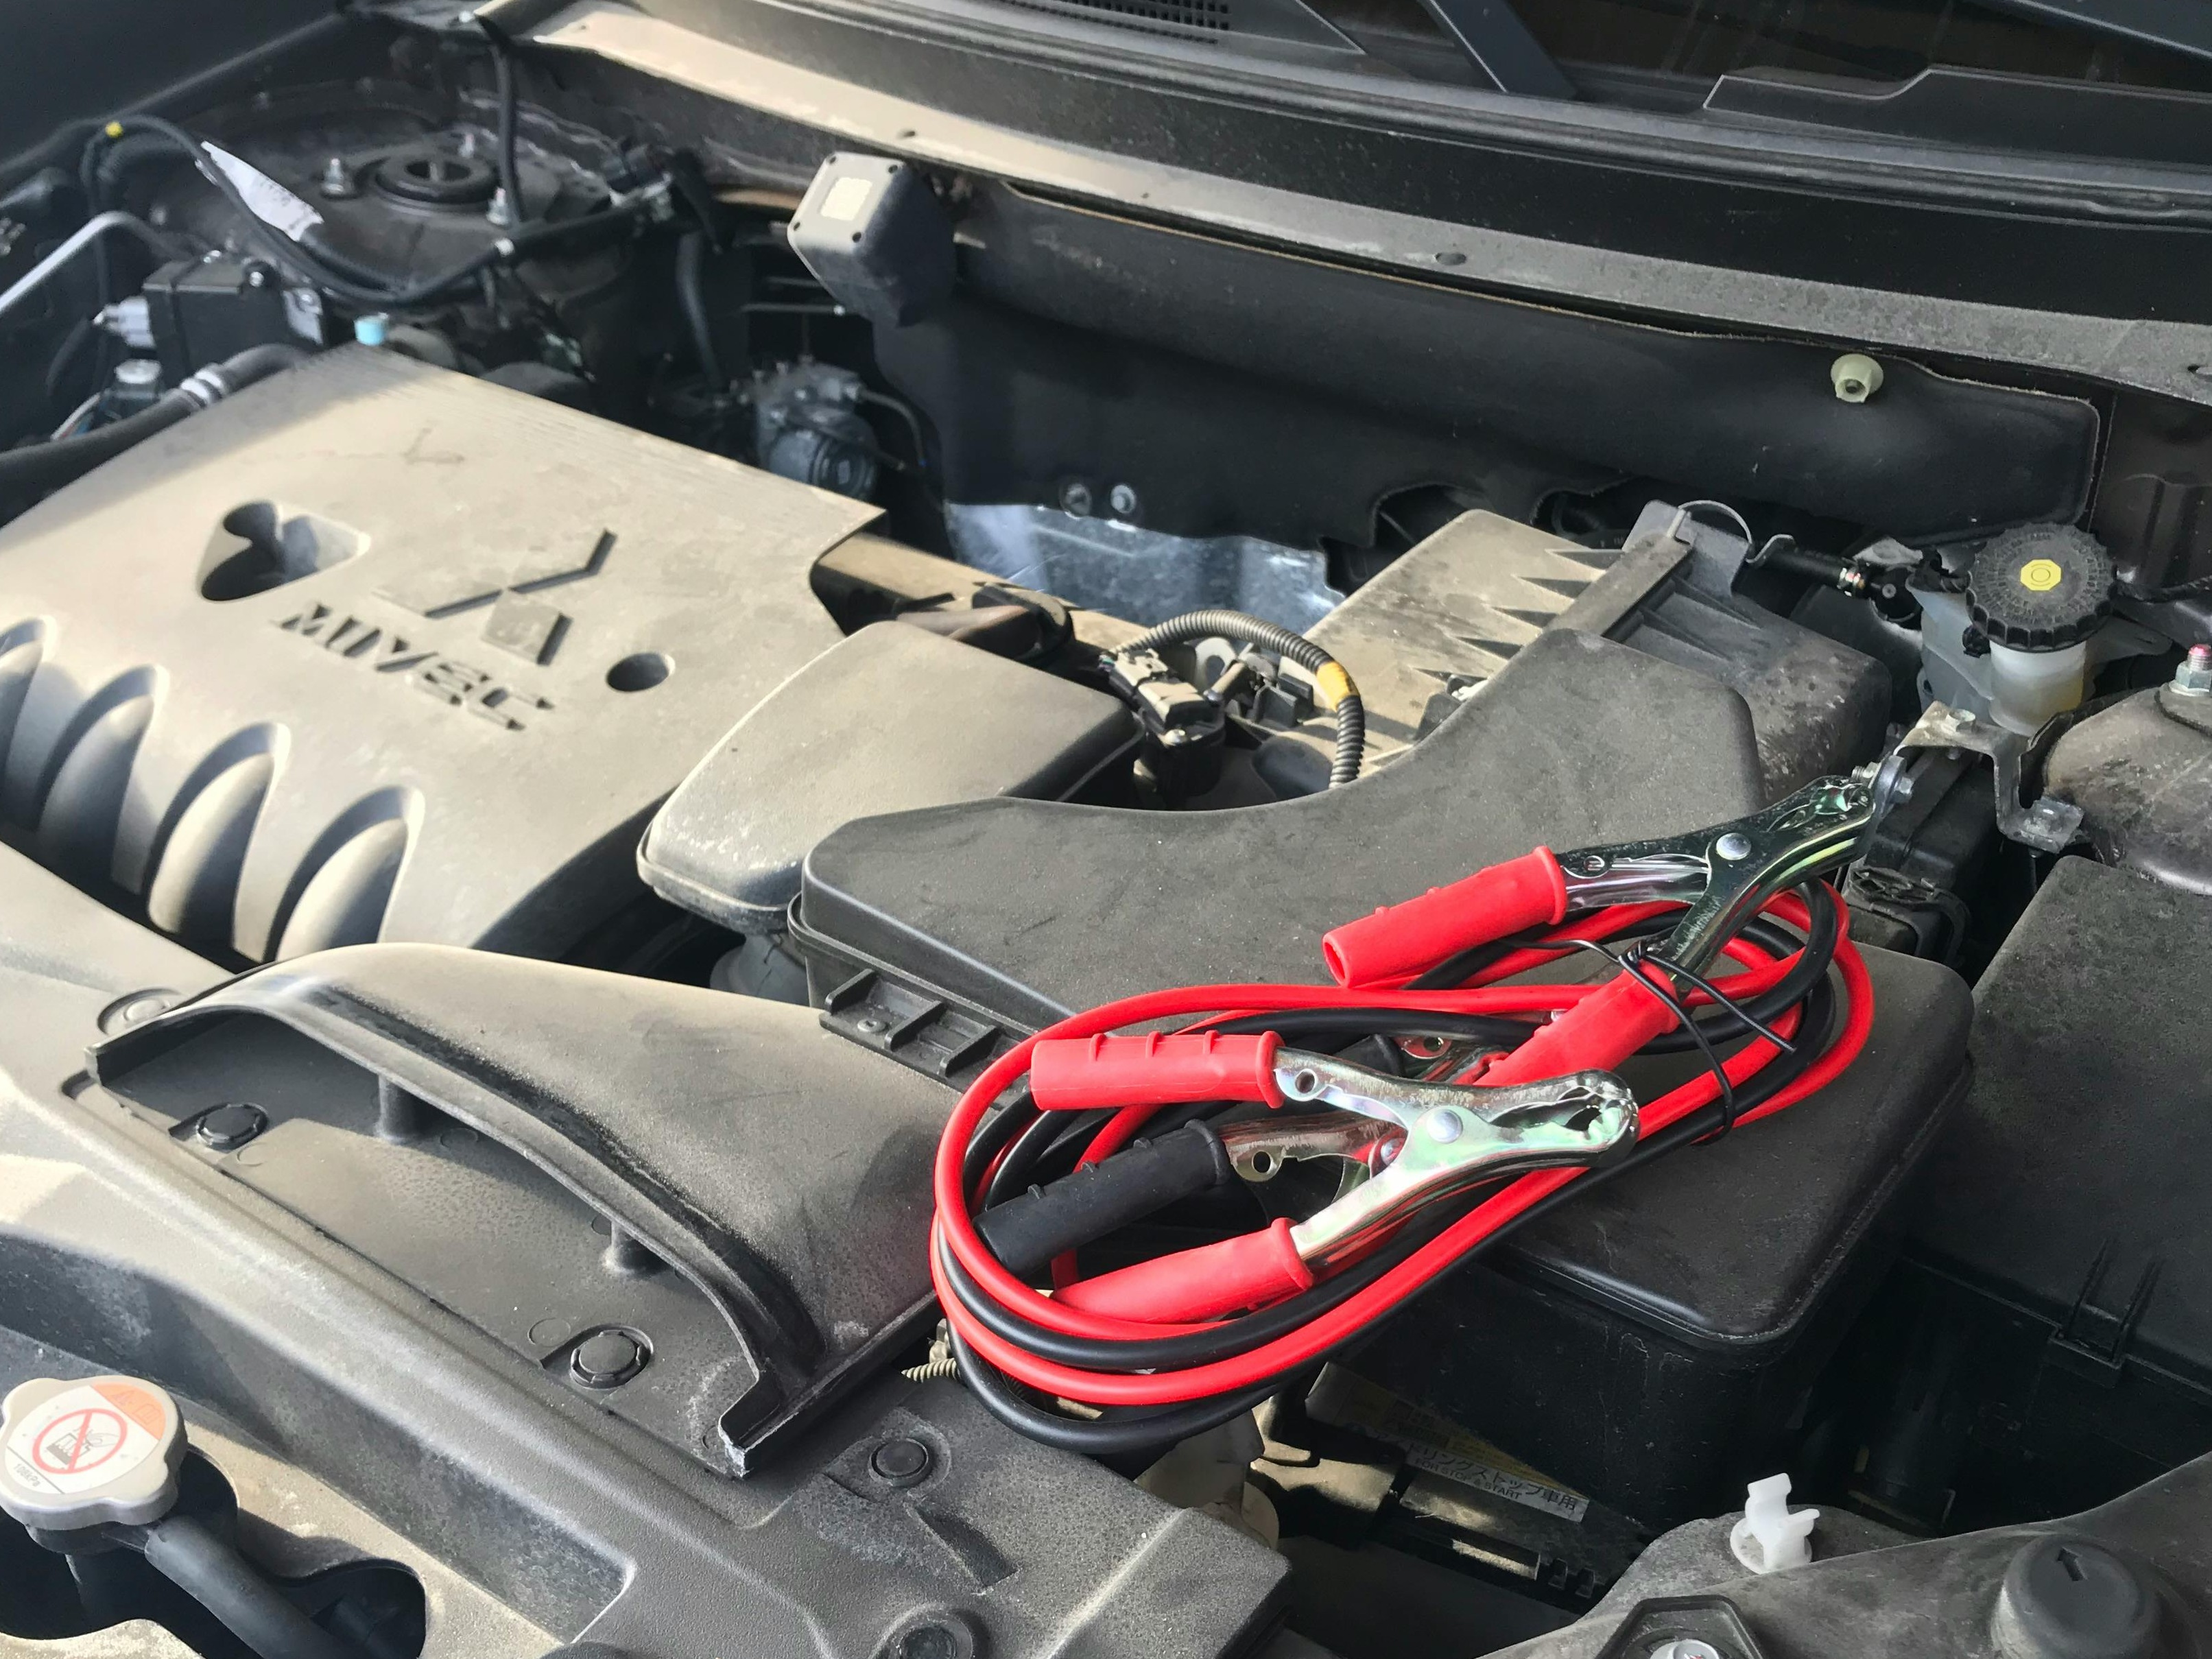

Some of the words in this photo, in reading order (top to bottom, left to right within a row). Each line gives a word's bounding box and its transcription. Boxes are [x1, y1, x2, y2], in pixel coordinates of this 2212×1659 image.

[270, 602, 554, 730] MIVEC
[1415, 1457, 1439, 1472] FOR
[1440, 1466, 1469, 1481] STOP
[1485, 1482, 1522, 1499] START
